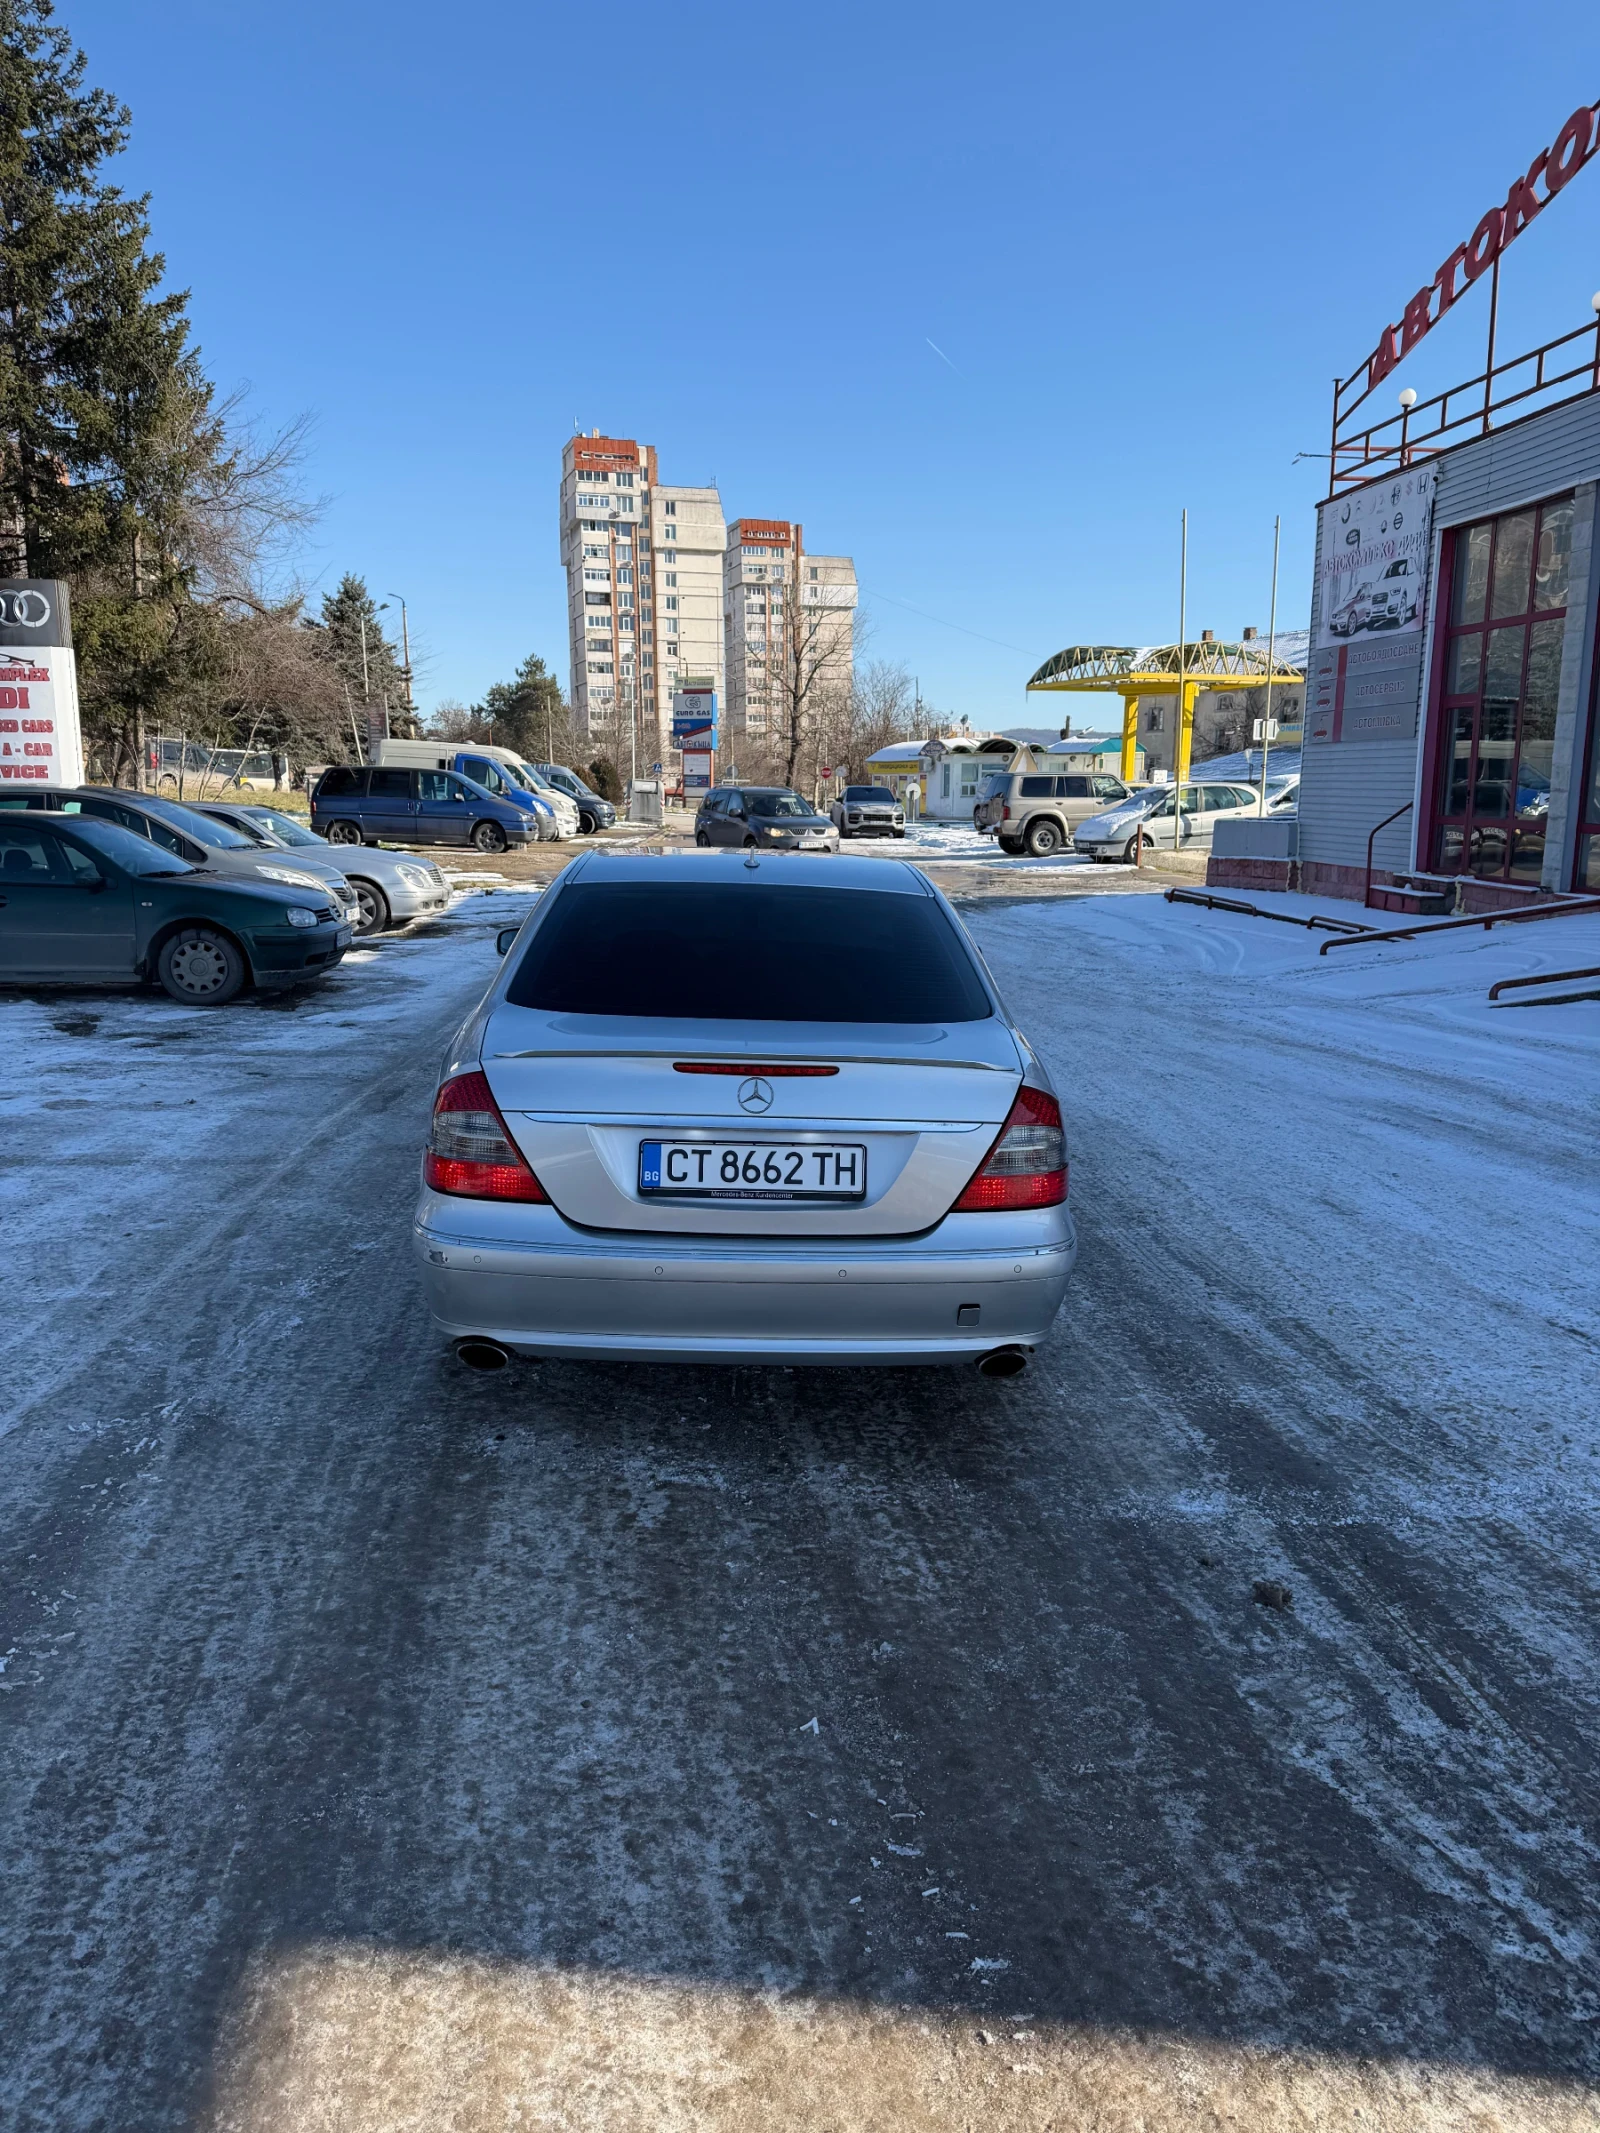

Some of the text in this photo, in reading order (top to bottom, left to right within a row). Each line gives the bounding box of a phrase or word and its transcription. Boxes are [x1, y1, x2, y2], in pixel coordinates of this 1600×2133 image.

[1369, 105, 1600, 391] АВТОКО
[1355, 681, 1405, 697] АВТОСЕРВИЗ
[21, 719, 53, 733] CARS
[2, 742, 12, 756] A
[24, 742, 53, 756] CAR
[0, 765, 48, 778] VICE
[667, 1148, 857, 1186] CT 8662 TH
[644, 1170, 659, 1182] BG
